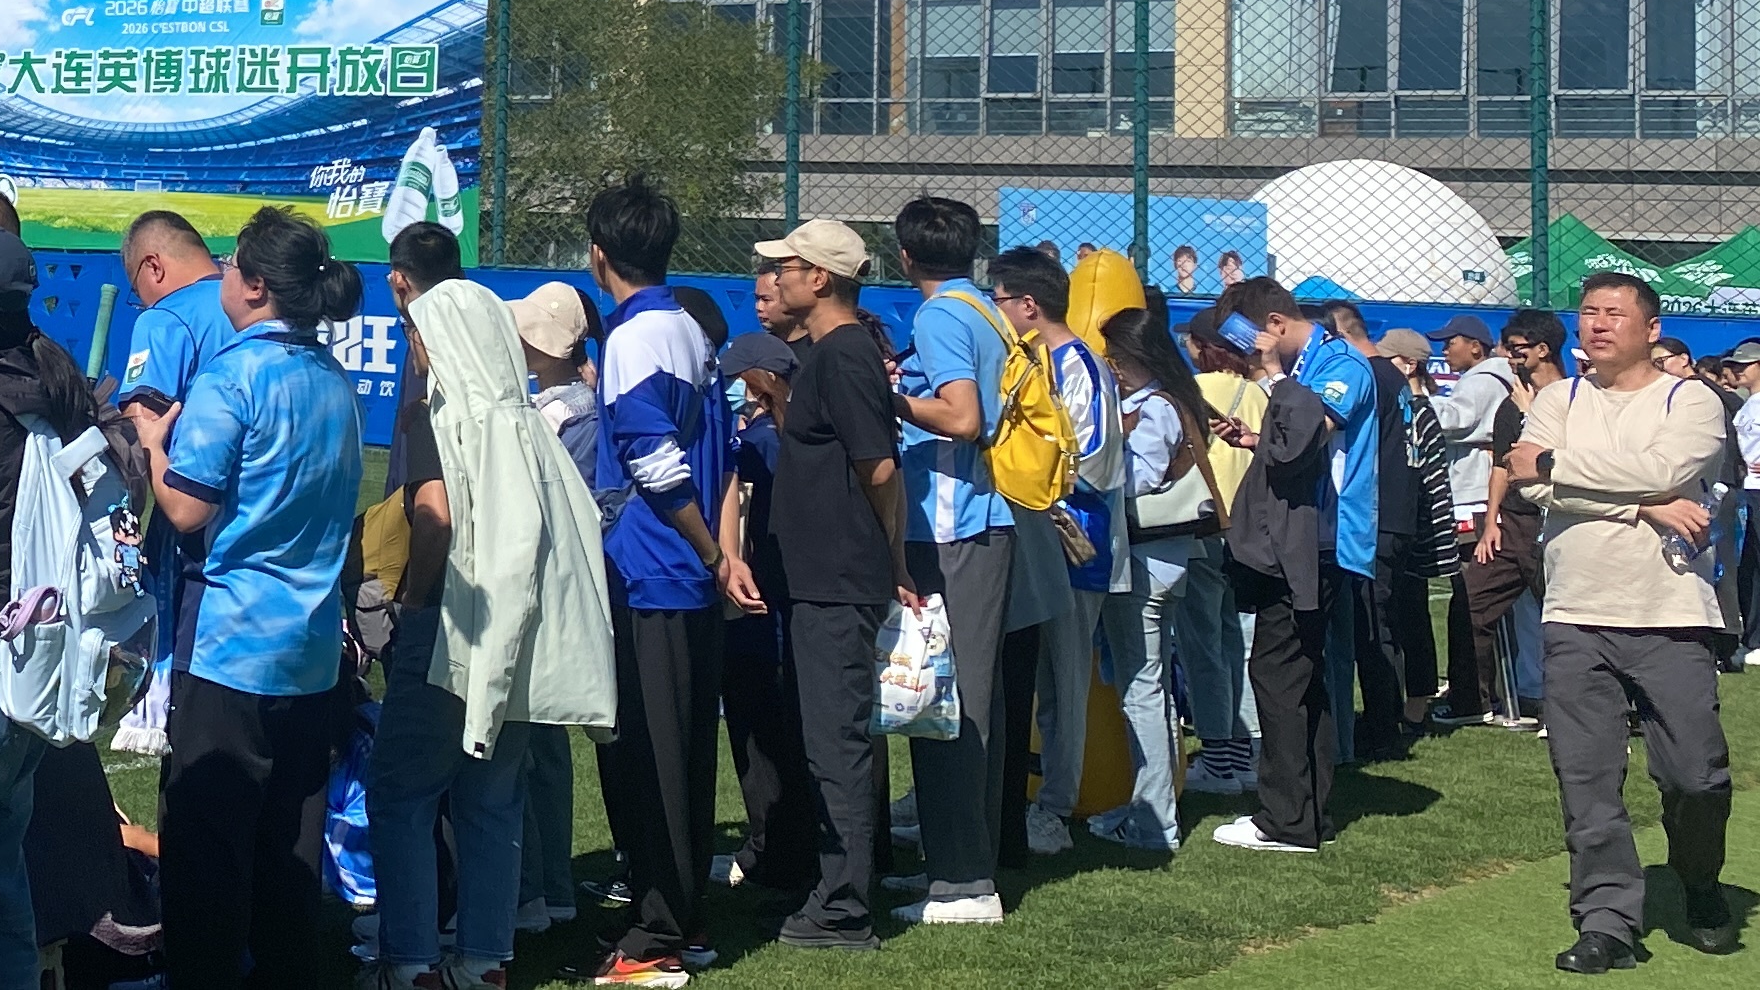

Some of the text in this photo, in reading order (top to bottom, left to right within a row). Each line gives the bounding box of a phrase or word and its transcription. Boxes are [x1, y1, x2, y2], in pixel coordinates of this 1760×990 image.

[121, 22, 149, 35] 2026
[209, 21, 230, 33] CSL
[309, 157, 367, 189] 你我的
